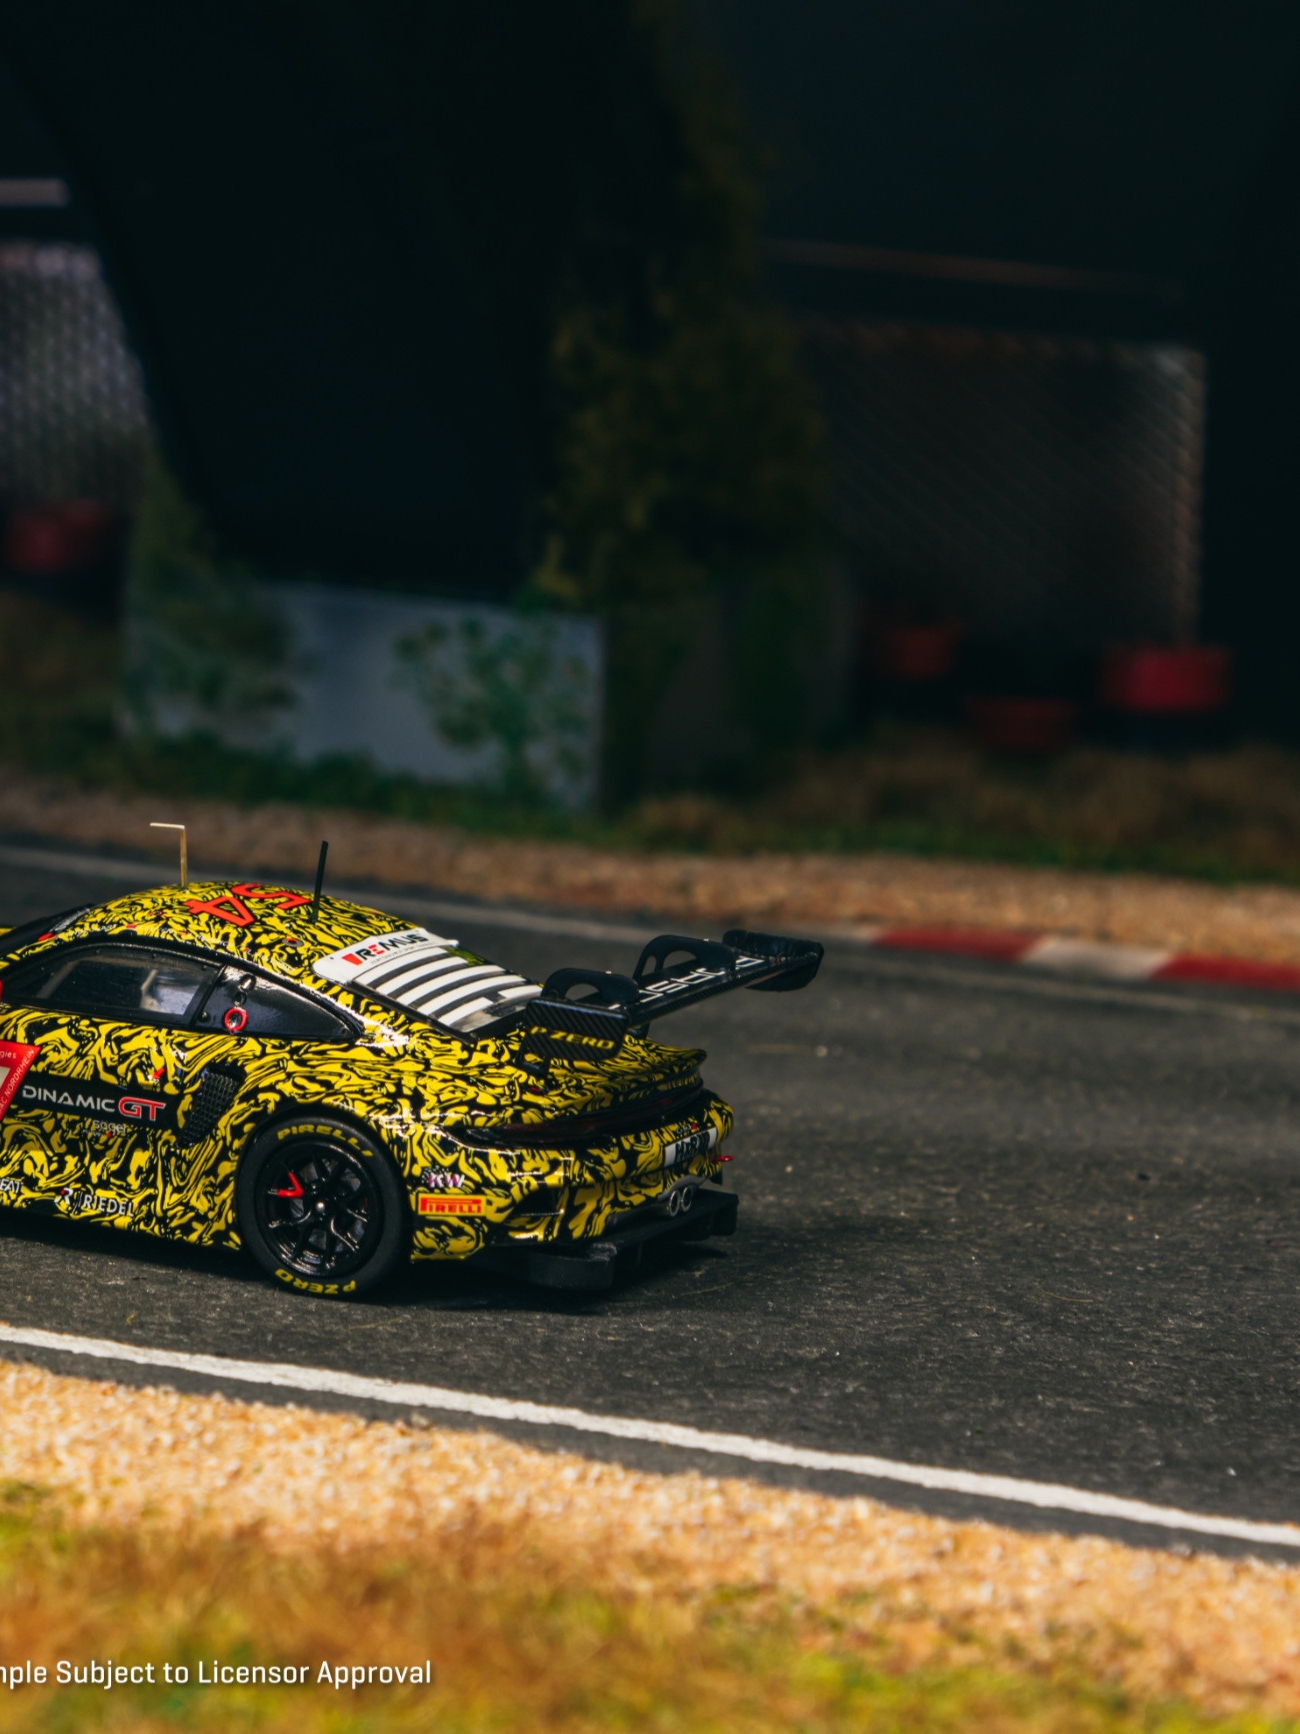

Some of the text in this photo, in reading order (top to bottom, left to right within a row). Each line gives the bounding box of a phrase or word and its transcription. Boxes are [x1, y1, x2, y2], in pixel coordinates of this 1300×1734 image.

[182, 884, 312, 928] 54
[355, 933, 429, 961] REMUS
[530, 1025, 615, 1050] P ZERO
[4, 1048, 36, 1099] NORDRHEIN
[22, 1085, 167, 1121] DINAMIC GT
[276, 1124, 373, 1157] PIRELLI
[83, 1193, 135, 1217] RIEDEL
[419, 1197, 482, 1213] PIRELLI
[274, 1268, 357, 1295] P ZERO
